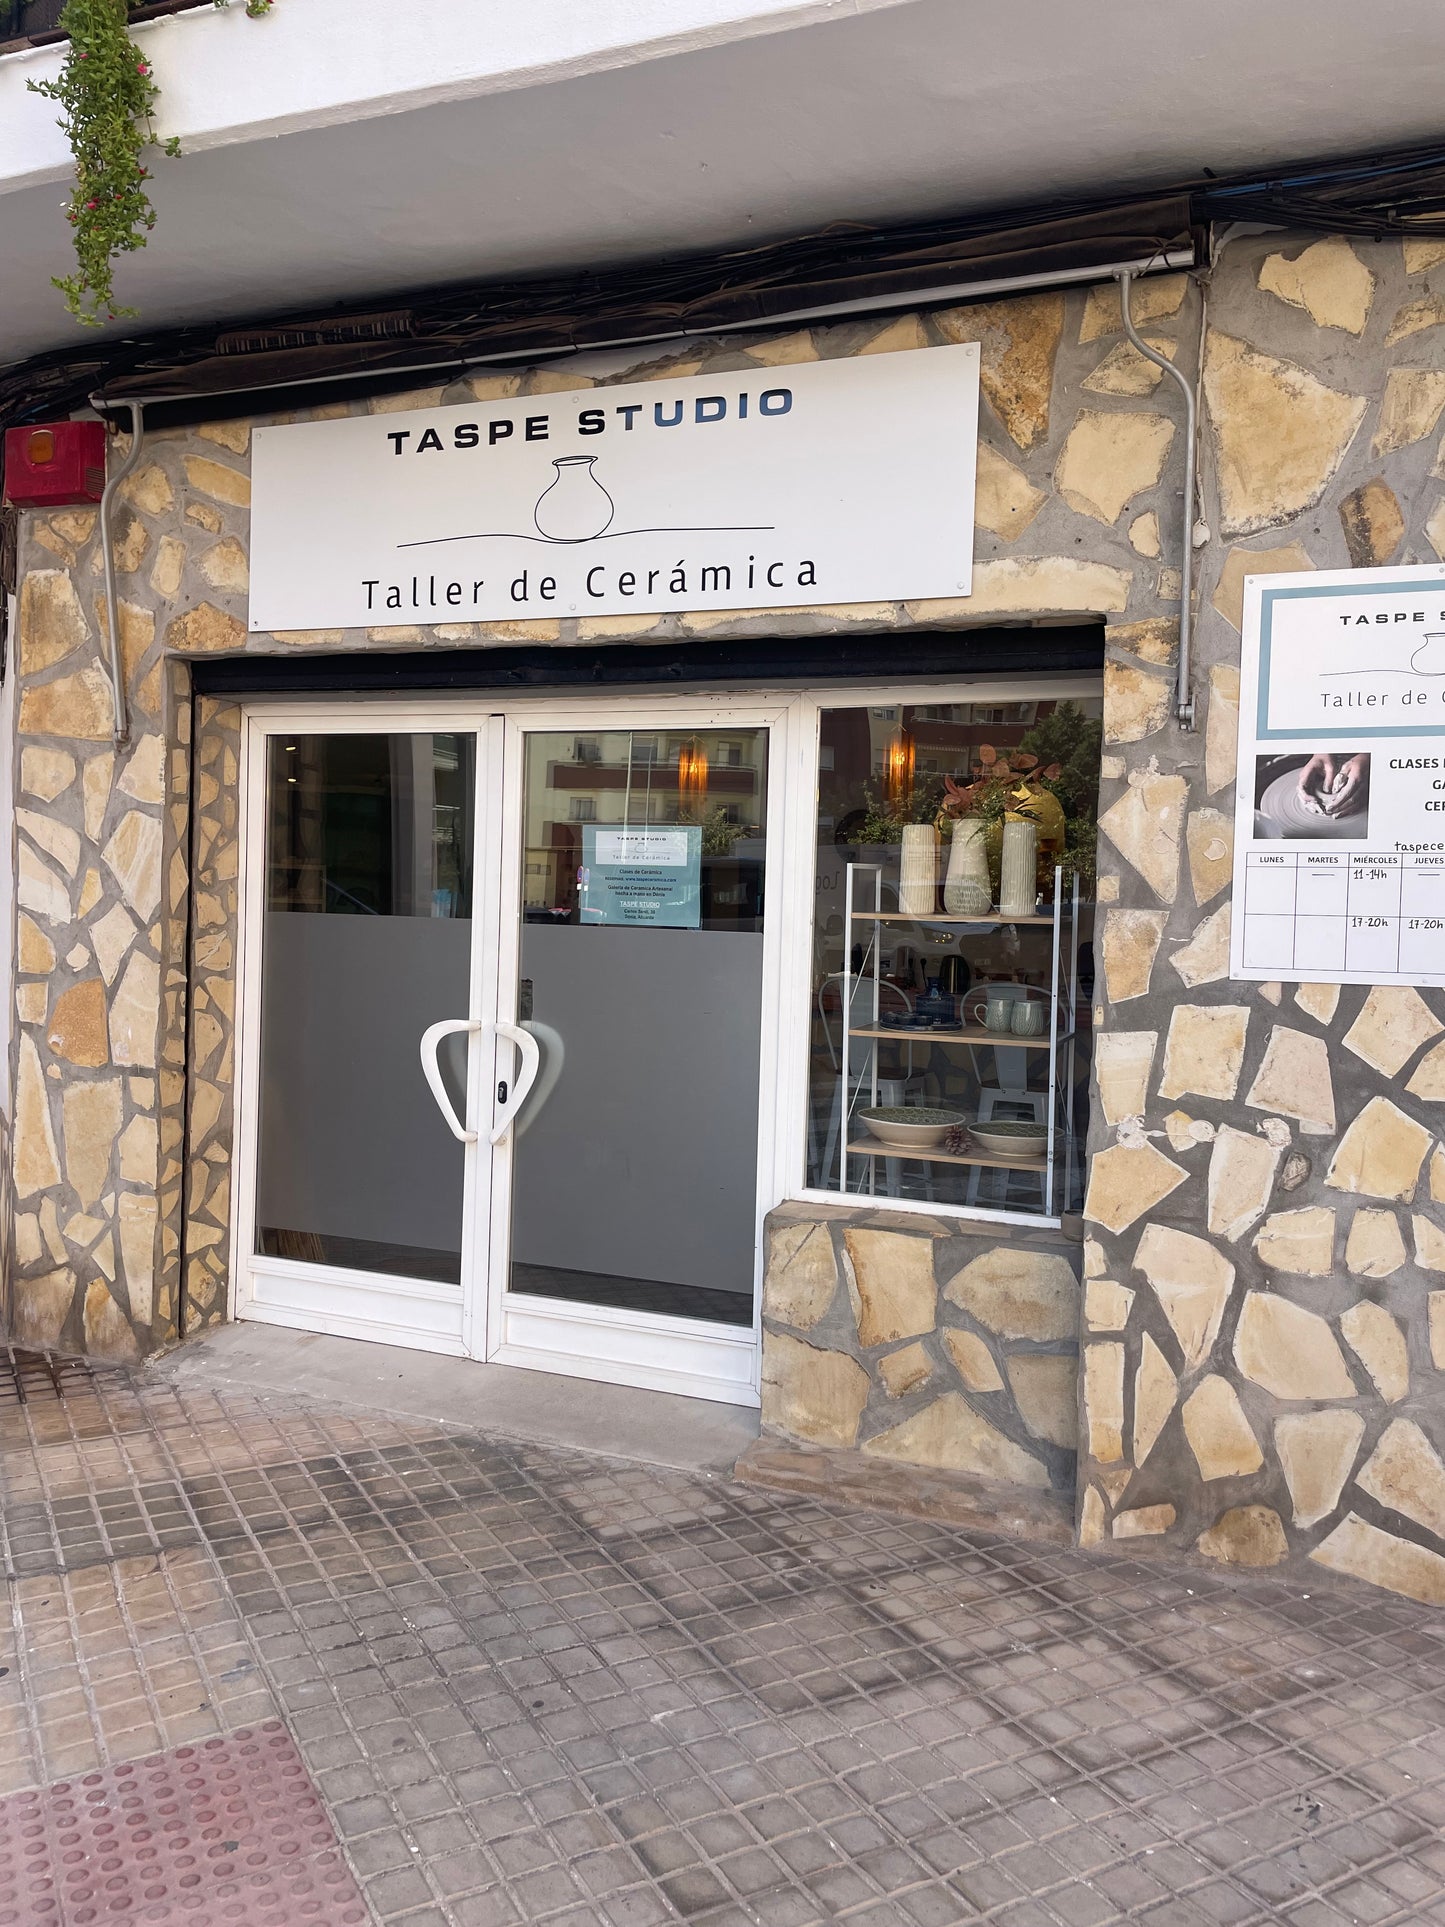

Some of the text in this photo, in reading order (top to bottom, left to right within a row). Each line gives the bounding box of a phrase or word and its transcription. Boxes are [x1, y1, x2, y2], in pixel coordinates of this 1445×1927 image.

[387, 388, 794, 455] TASPE STUDIO
[361, 554, 818, 609] Taller de Cerámica
[1339, 612, 1425, 626] TASPE
[1320, 691, 1389, 708] Taller
[1401, 689, 1427, 705] de
[1389, 758, 1439, 769] CLASES
[1394, 841, 1445, 853] taspece
[1307, 856, 1339, 864] MARTES
[1353, 855, 1398, 864] MIÉRCOLES
[1414, 857, 1444, 865] JUEVES
[639, 901, 661, 909] STUDIO
[1351, 917, 1389, 928] 17-20h
[1408, 919, 1444, 929] 17-20h
